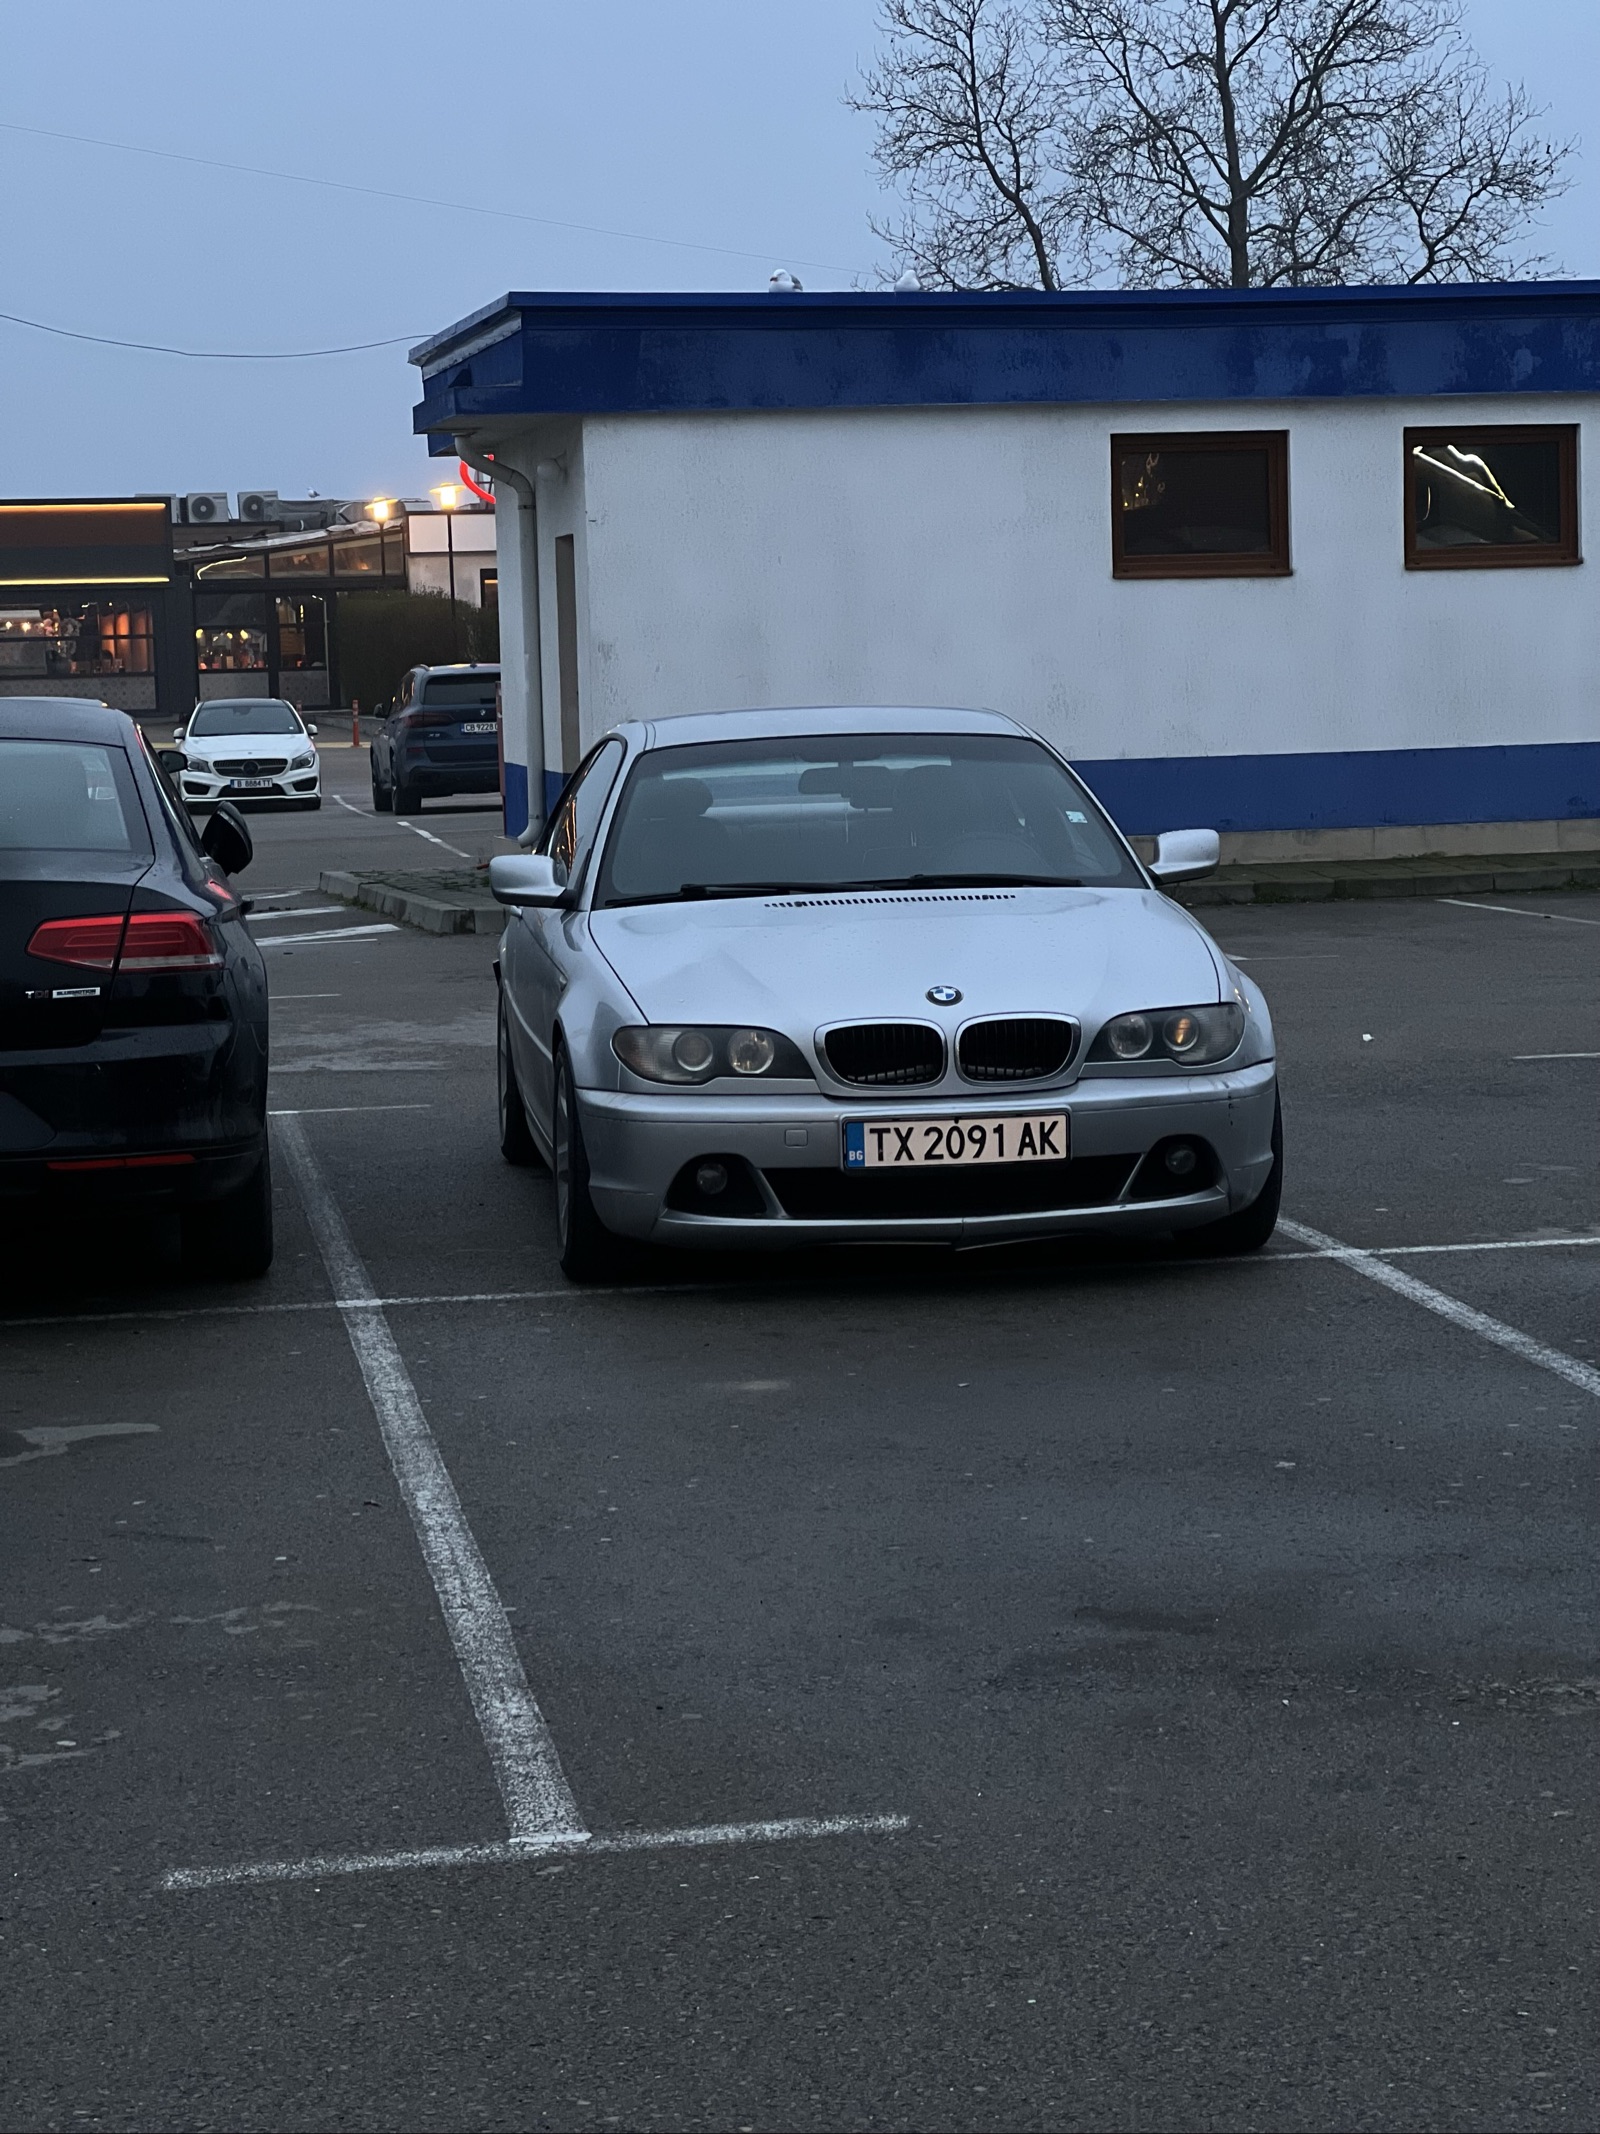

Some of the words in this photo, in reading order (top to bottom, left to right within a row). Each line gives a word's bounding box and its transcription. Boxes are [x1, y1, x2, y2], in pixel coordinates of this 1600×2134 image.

[25, 990, 49, 999] TDI
[869, 1127, 915, 1162] TX
[924, 1123, 1004, 1160] 2091
[1017, 1121, 1060, 1157] AK
[849, 1150, 863, 1160] BG
